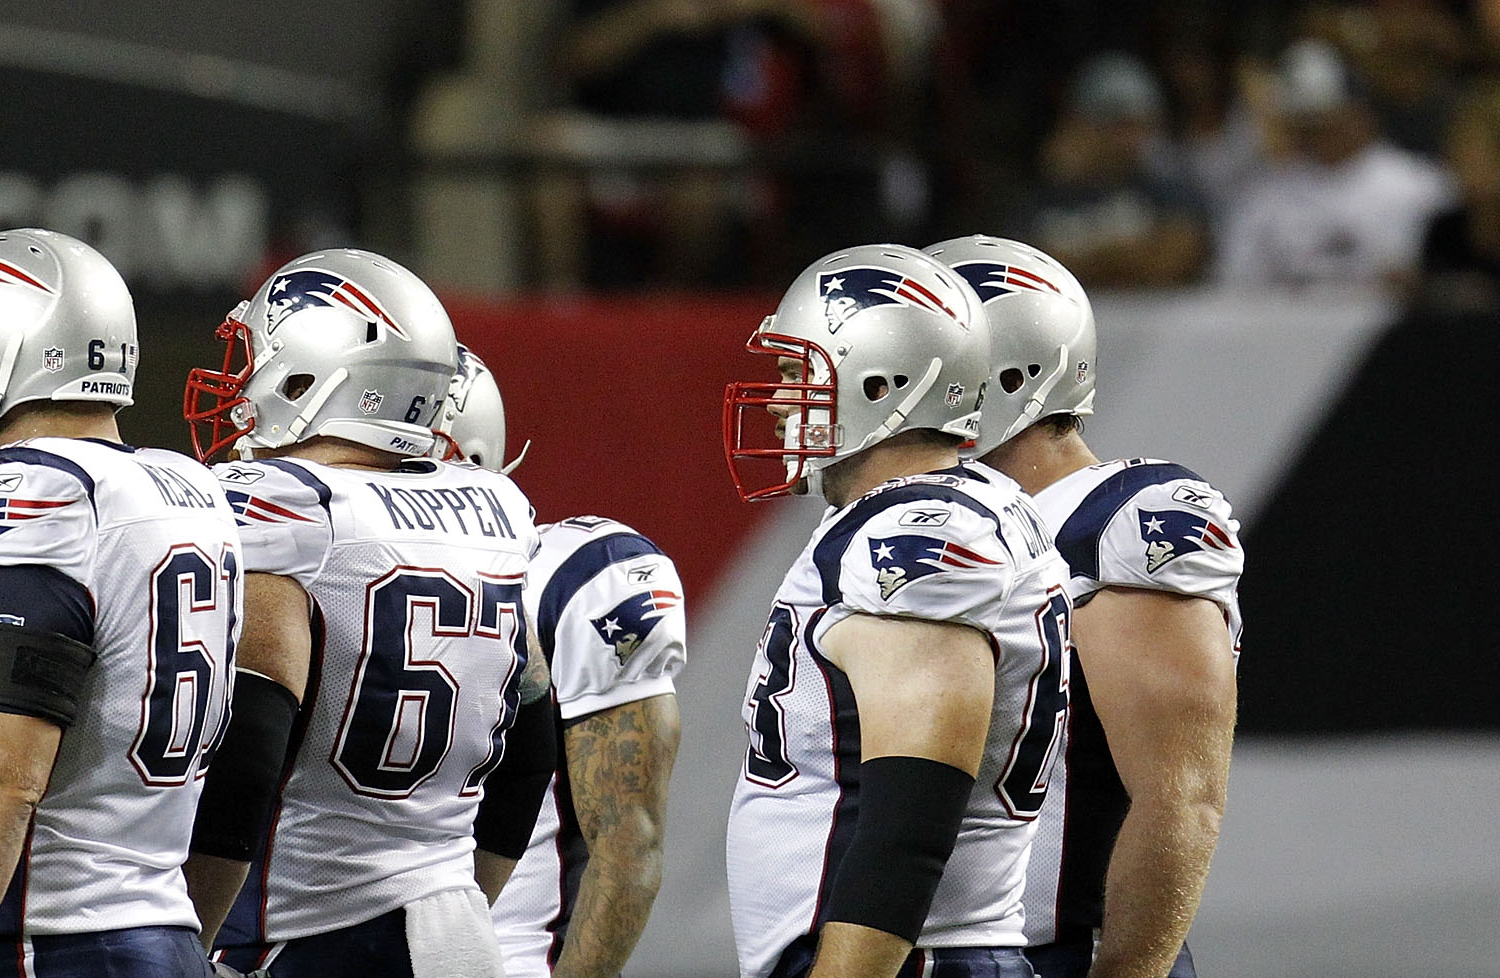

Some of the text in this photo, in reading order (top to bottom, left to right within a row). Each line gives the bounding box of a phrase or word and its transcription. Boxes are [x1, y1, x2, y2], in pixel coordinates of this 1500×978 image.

[81, 381, 130, 396] PATRIOTS
[366, 482, 517, 540] KOPPEN
[128, 542, 242, 787] 61
[329, 565, 528, 800] 67
